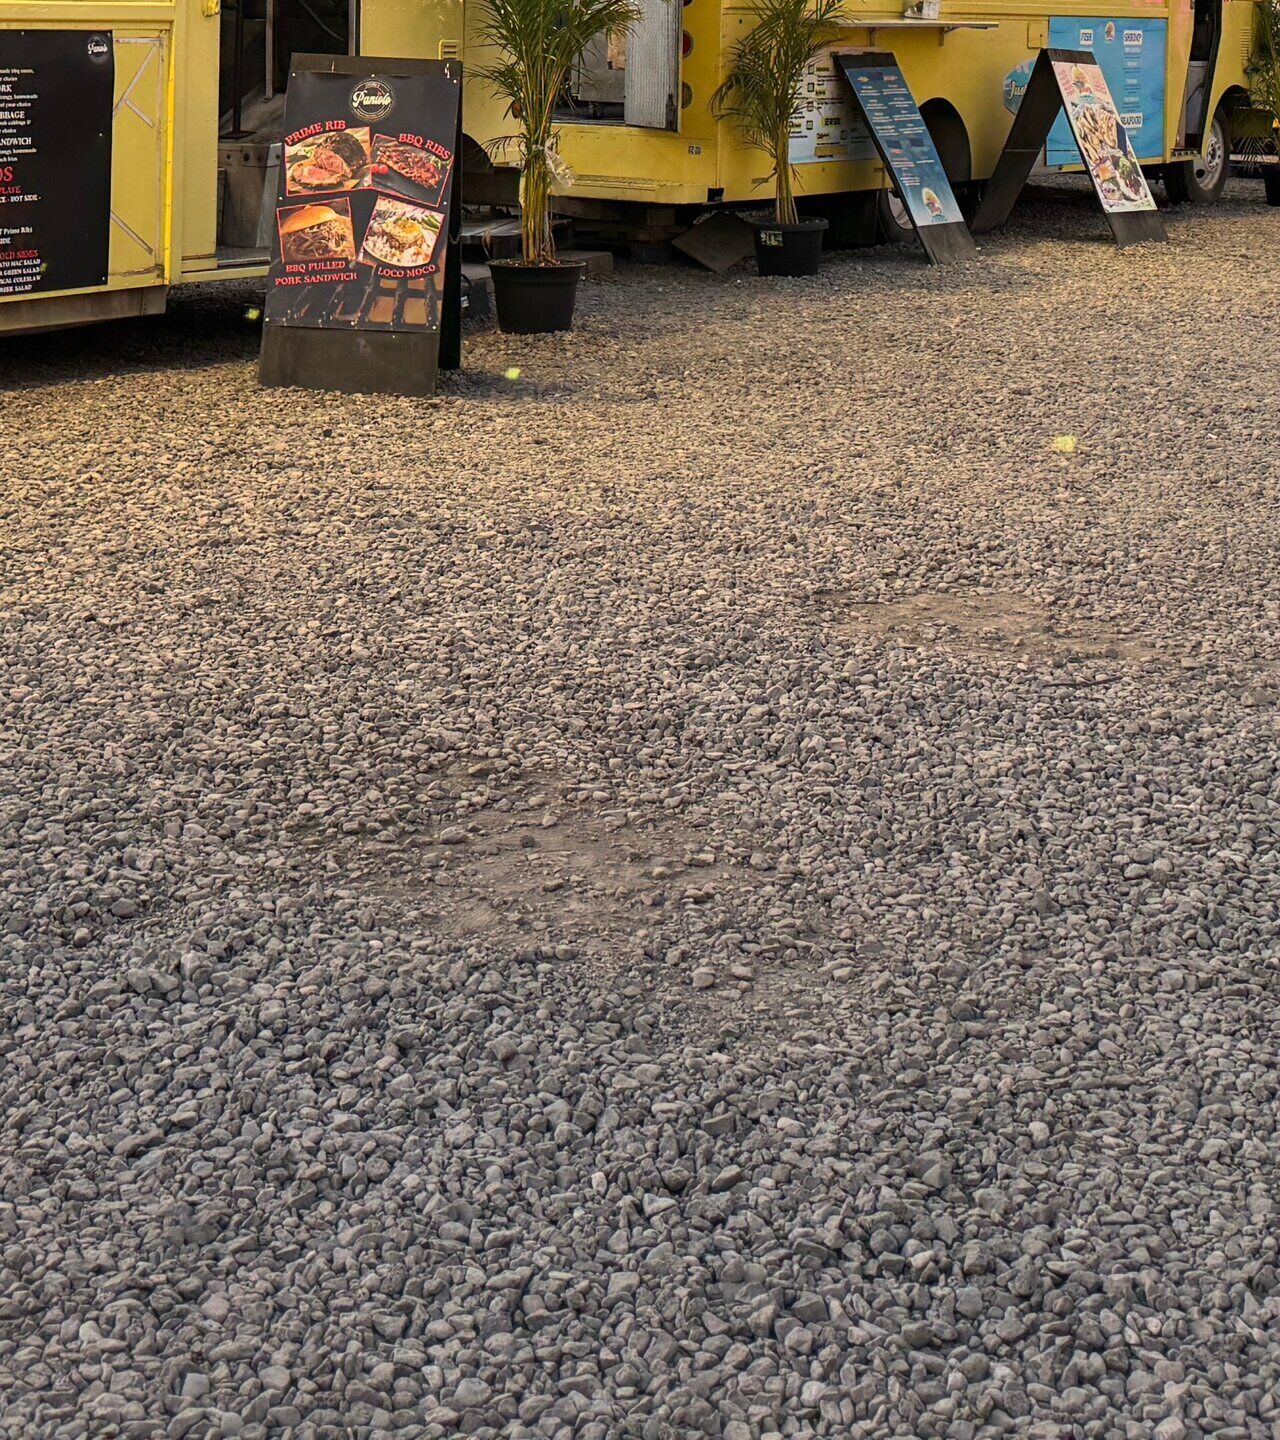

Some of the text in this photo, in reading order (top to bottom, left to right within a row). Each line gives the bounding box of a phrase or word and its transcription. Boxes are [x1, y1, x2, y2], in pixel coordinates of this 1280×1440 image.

[353, 90, 392, 107] Paniolo
[285, 120, 346, 145] PRIME RIB
[399, 134, 451, 160] BBQ RIBS
[16, 250, 38, 258] SIDES
[286, 261, 345, 272] BBQ PULLED
[378, 265, 436, 277] LOCO MOCO
[275, 273, 357, 285] PORK SANDWICH
